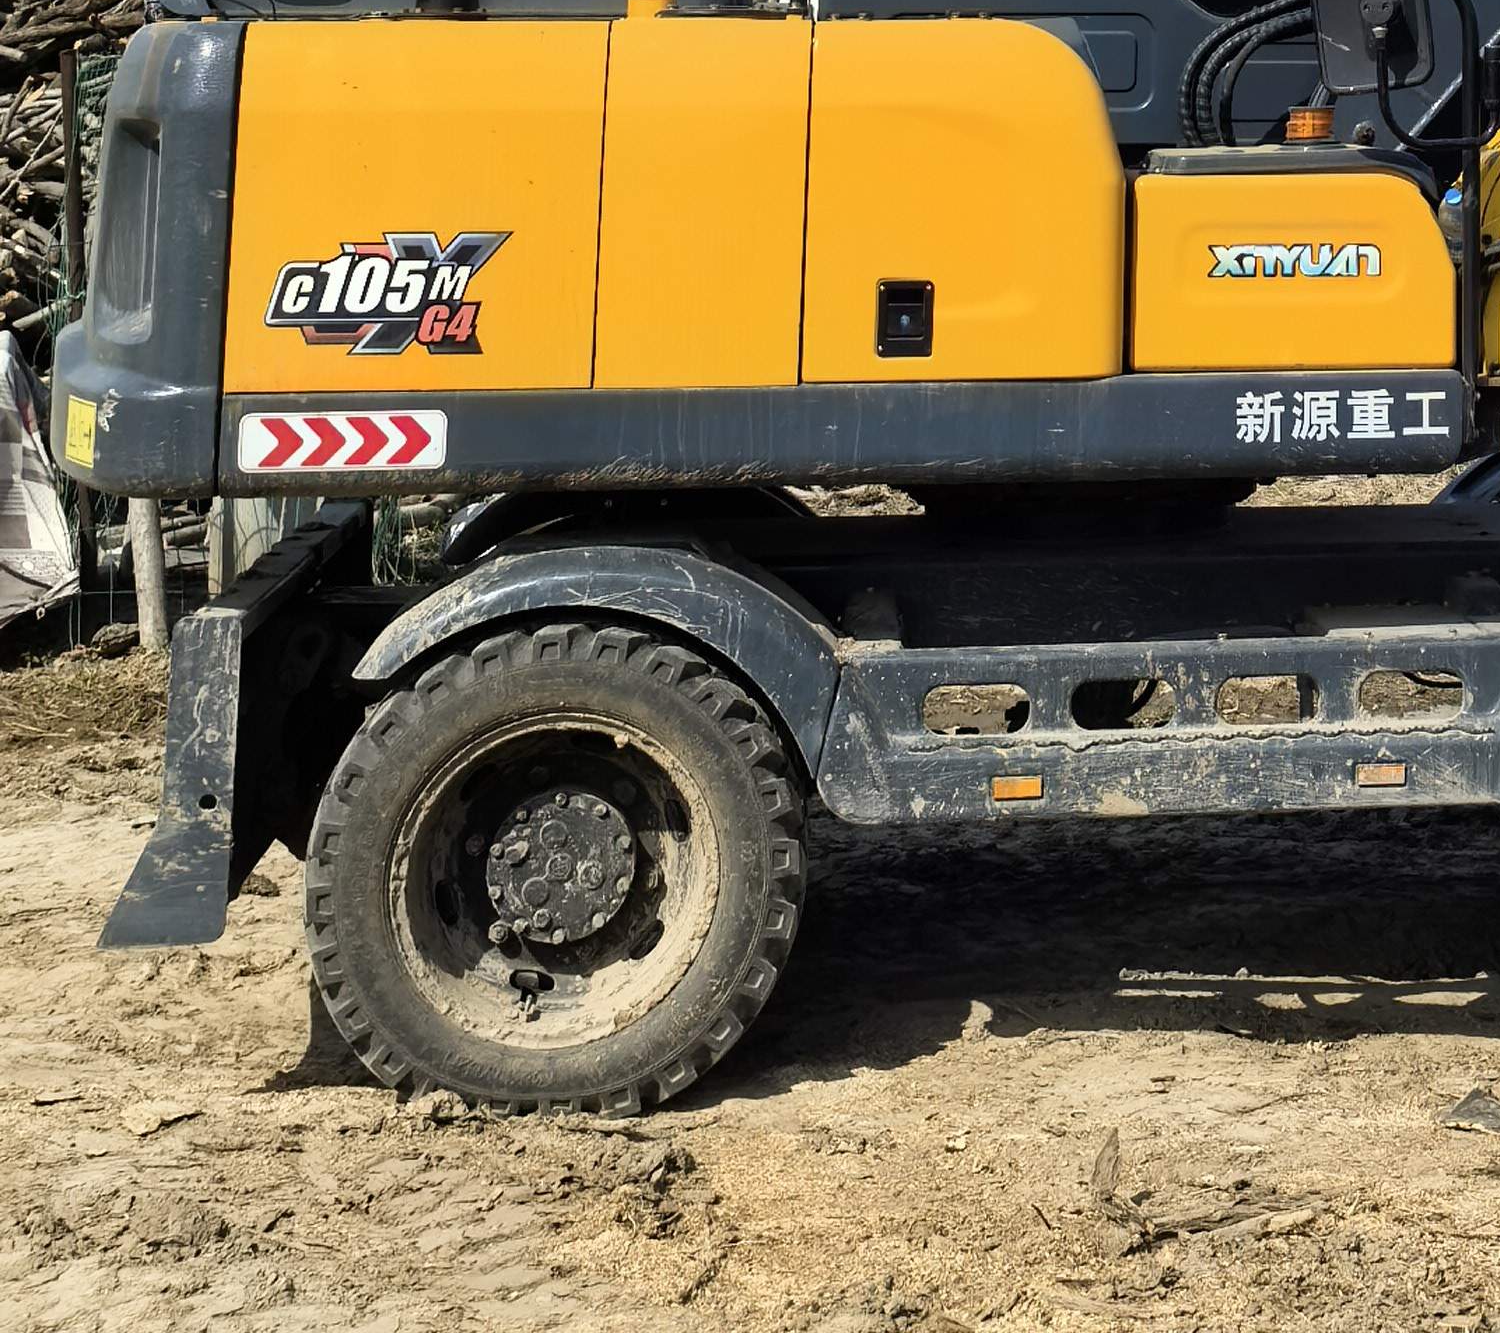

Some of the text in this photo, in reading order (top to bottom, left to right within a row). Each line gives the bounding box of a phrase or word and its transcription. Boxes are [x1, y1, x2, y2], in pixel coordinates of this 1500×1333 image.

[417, 303, 479, 345] G4
[1236, 388, 1450, 443] 新源重工
